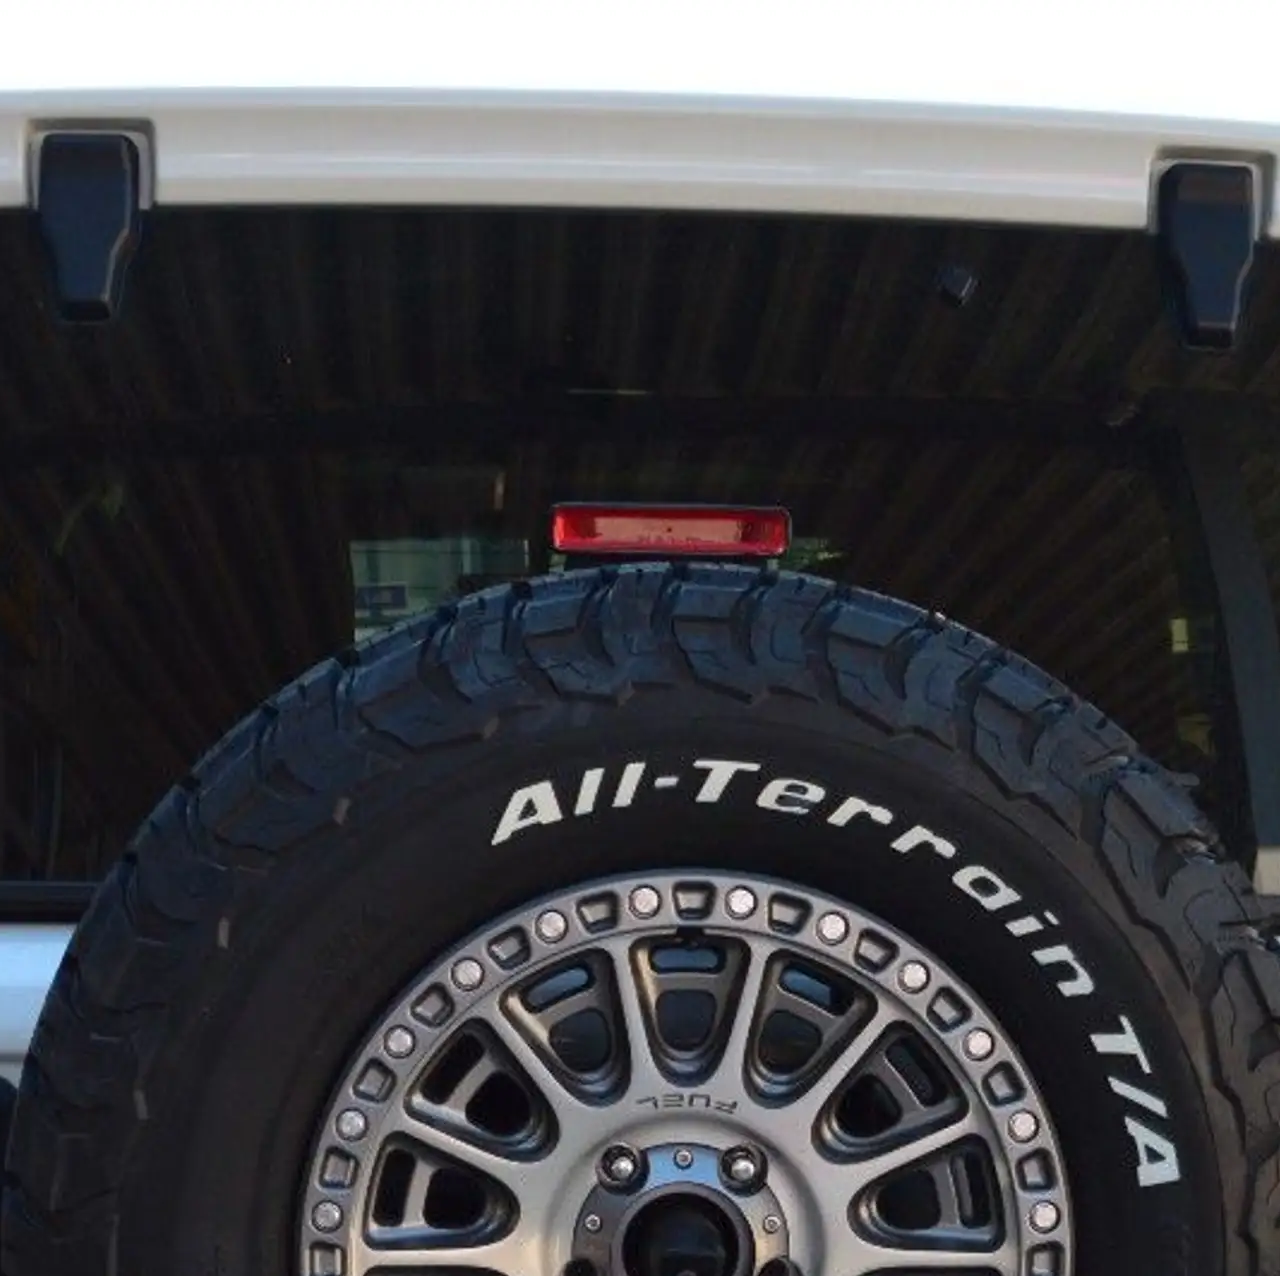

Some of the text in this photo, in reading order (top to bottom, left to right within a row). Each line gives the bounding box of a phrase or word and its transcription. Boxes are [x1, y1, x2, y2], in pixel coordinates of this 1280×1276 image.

[490, 759, 1182, 1188] All-Terrain T/A
[635, 1093, 738, 1115] FUEL
